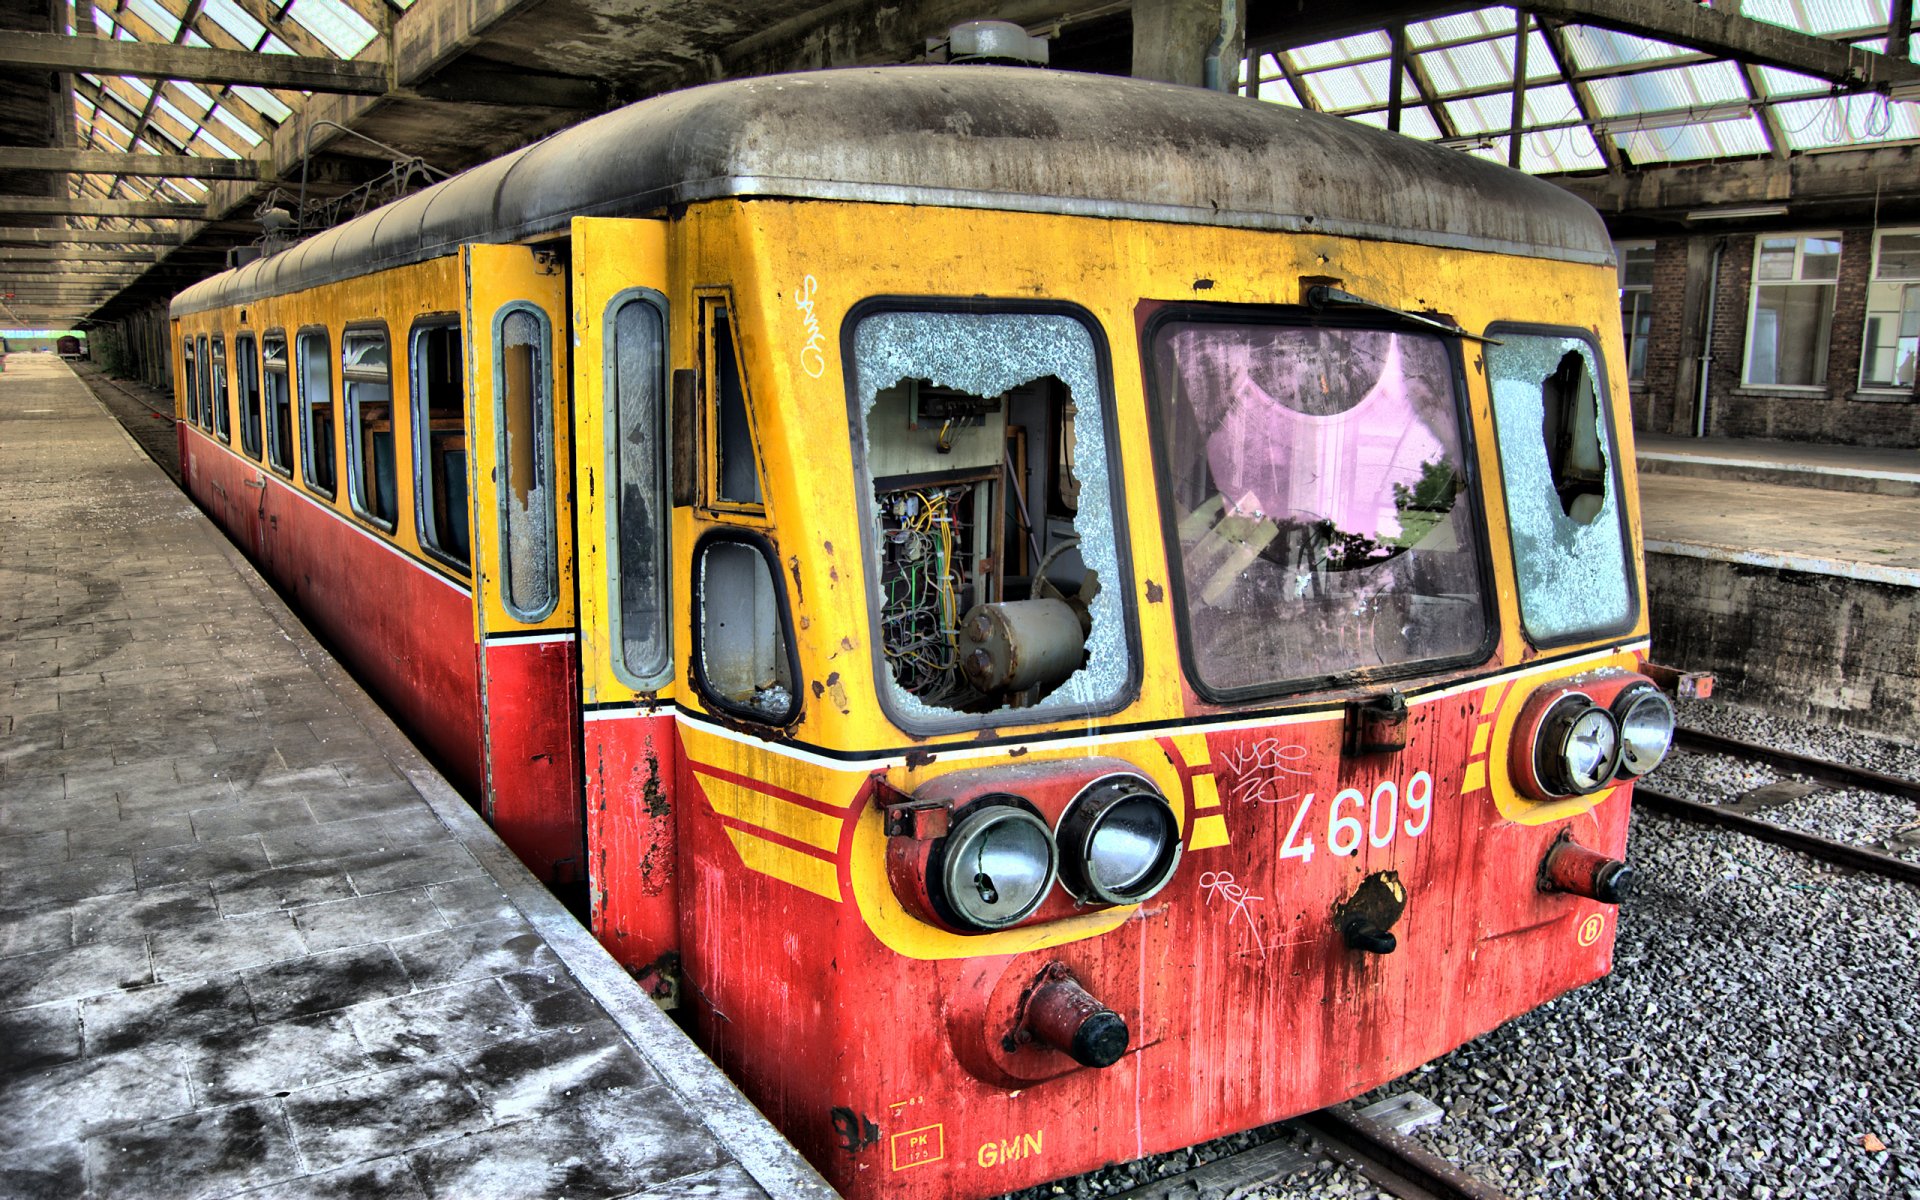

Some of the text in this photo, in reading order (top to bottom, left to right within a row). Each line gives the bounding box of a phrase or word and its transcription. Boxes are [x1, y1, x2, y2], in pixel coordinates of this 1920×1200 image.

[1279, 770, 1432, 863] 4609
[910, 1134, 928, 1148] PK
[977, 1130, 1044, 1168] GMN
